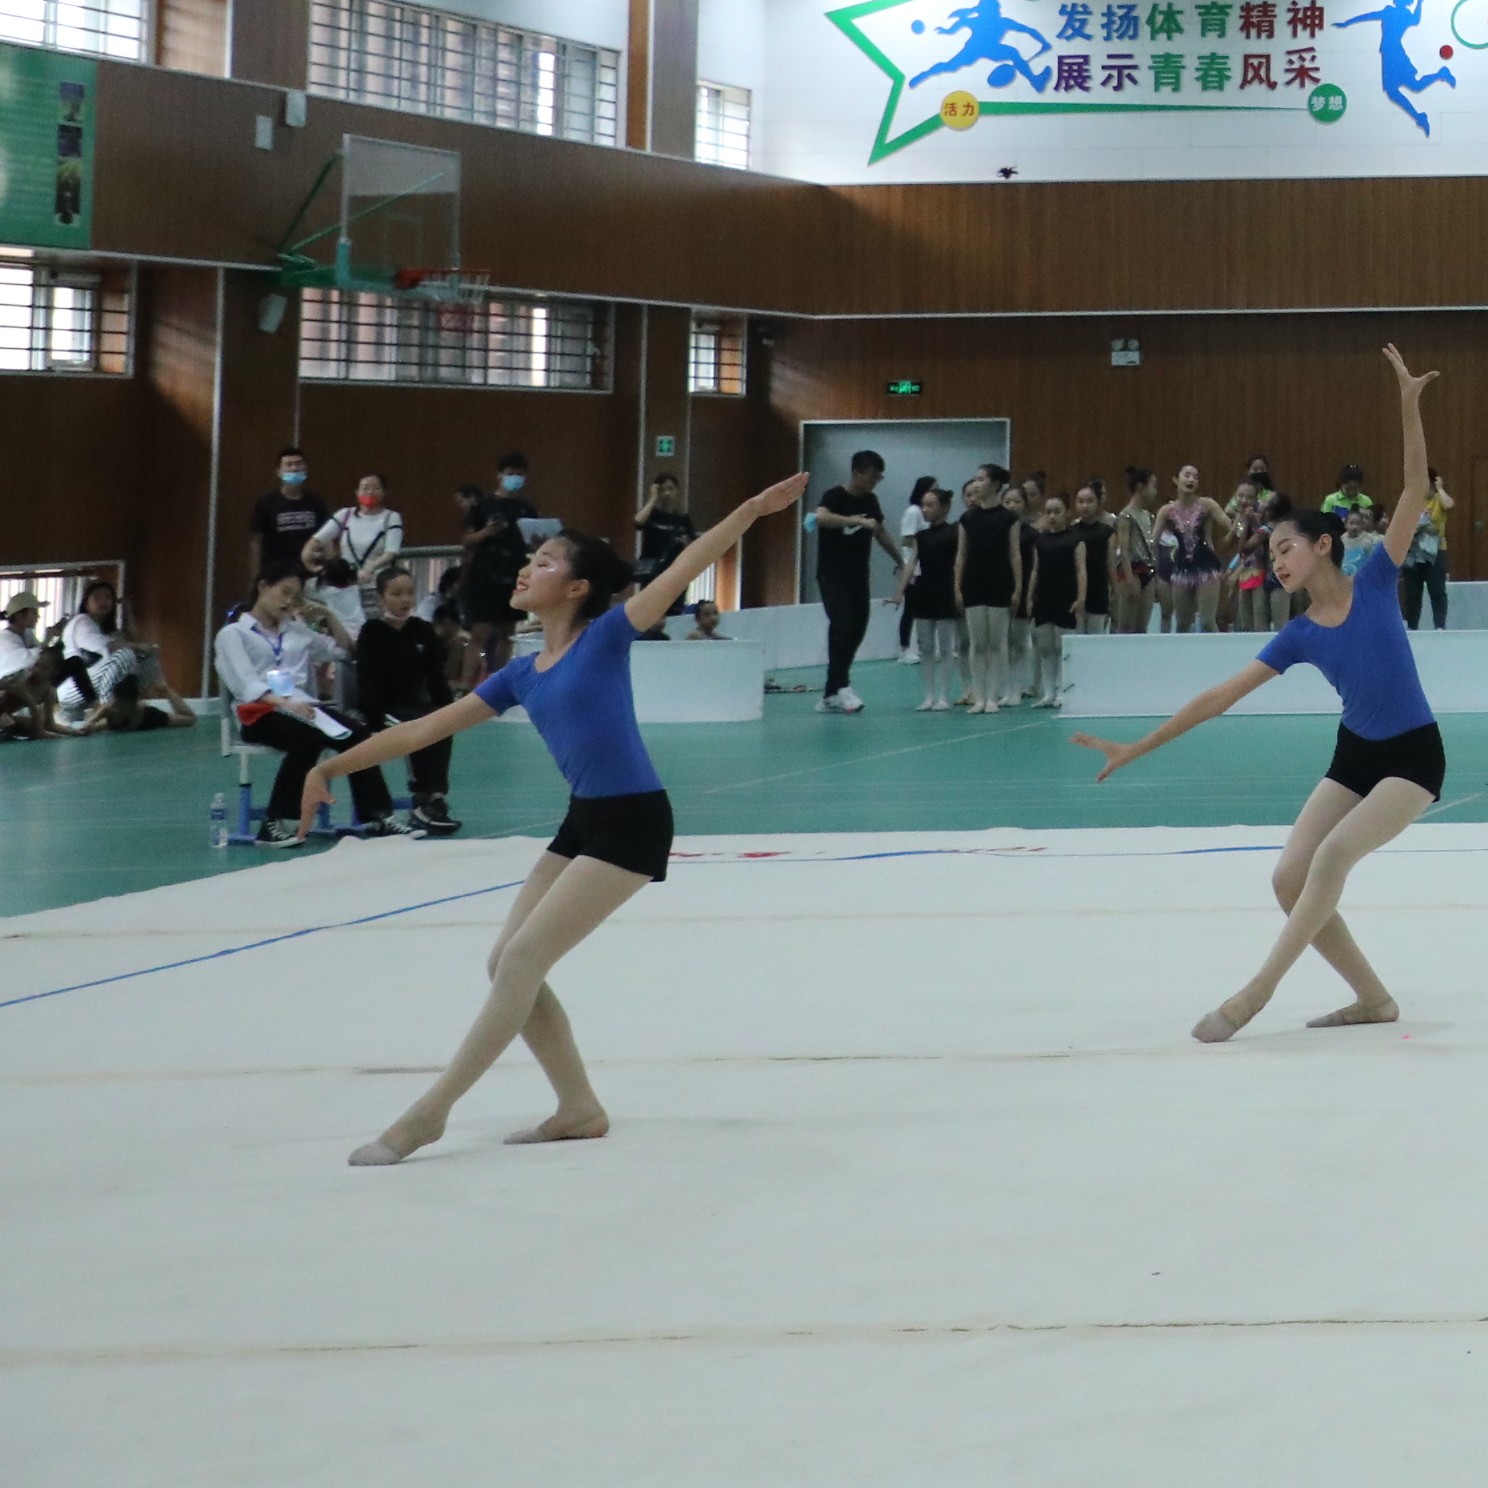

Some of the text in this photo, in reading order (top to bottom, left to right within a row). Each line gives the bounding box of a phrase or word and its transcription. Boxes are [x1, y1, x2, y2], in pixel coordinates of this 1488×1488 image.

[1056, 0, 1326, 42] 发扬体育精神
[1053, 46, 1322, 93] 展示青春风采
[943, 101, 975, 117] 活力
[1310, 95, 1344, 112] 梦想
